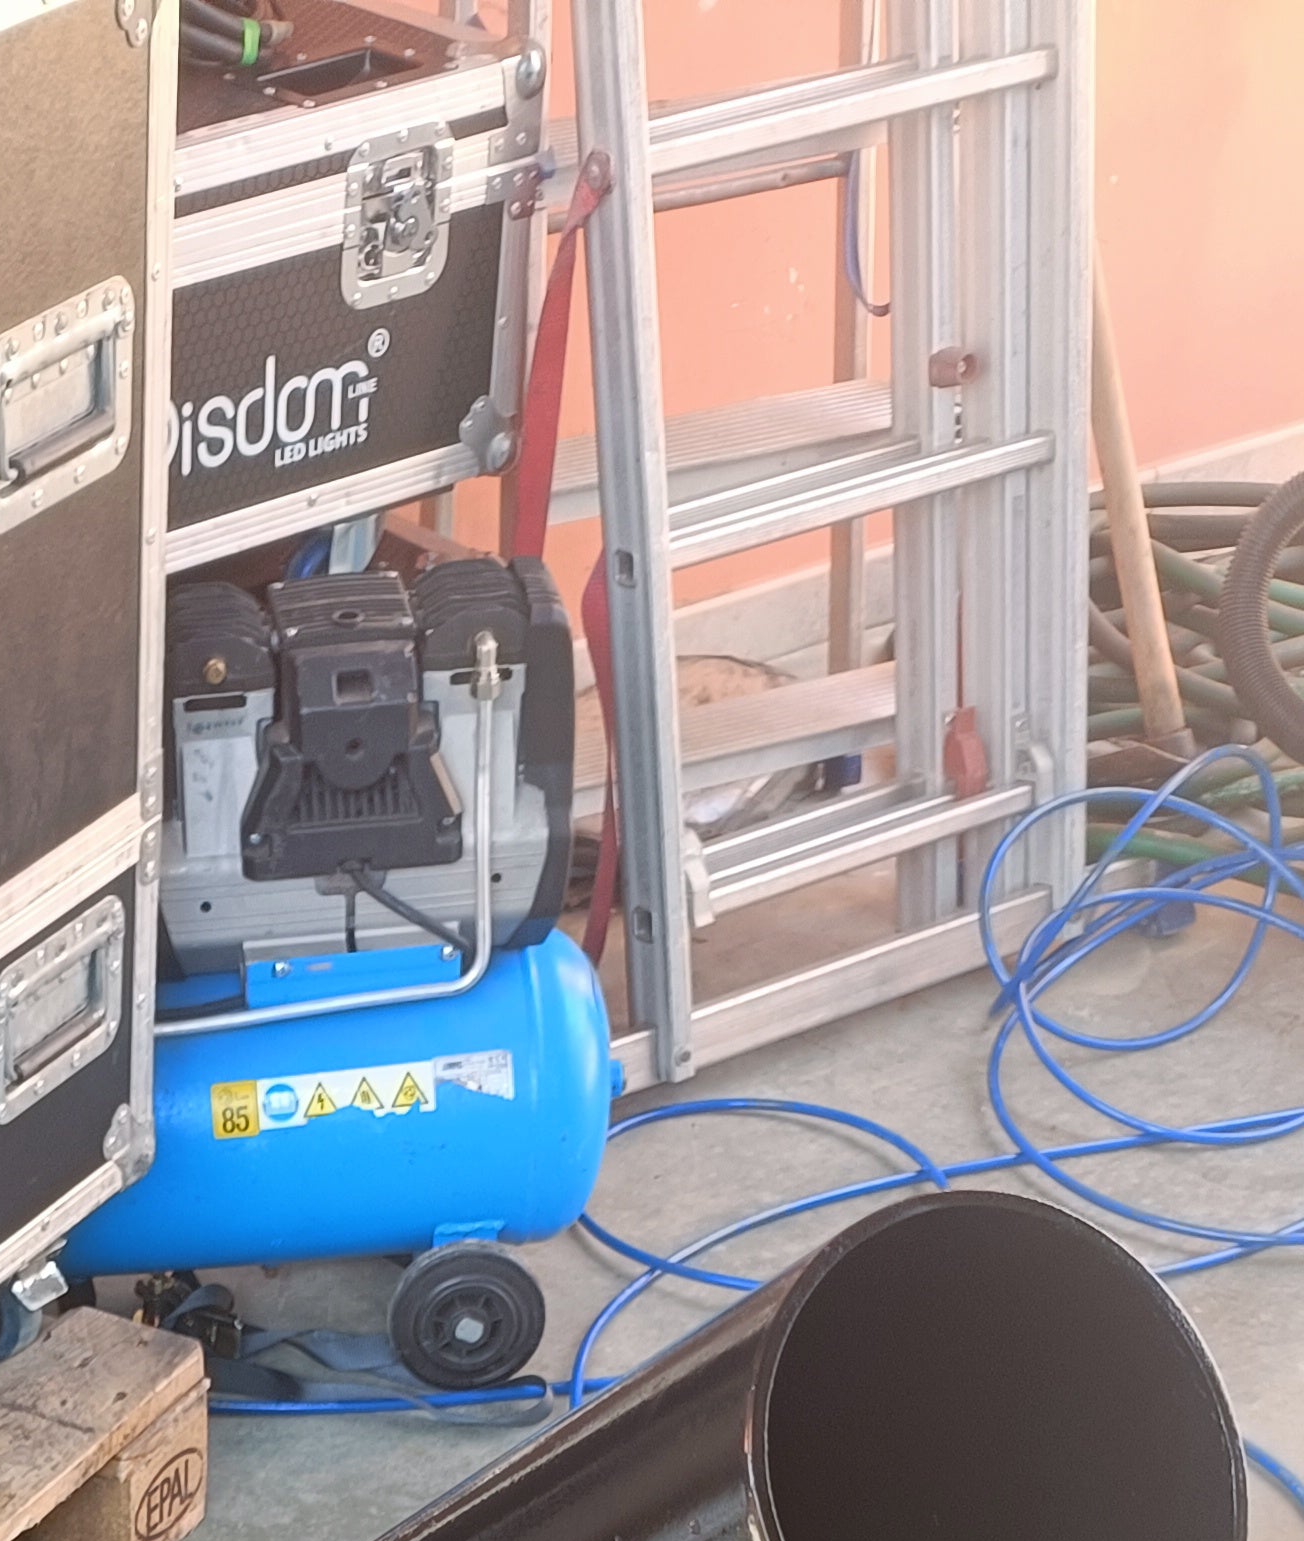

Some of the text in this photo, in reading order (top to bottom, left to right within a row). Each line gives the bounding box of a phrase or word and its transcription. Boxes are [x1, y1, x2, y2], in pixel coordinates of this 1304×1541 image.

[348, 377, 379, 399] LINE
[168, 354, 369, 477] isdom
[274, 423, 369, 468] LED LIGHTS
[222, 1104, 250, 1134] 85
[145, 1458, 195, 1536] EPAL
